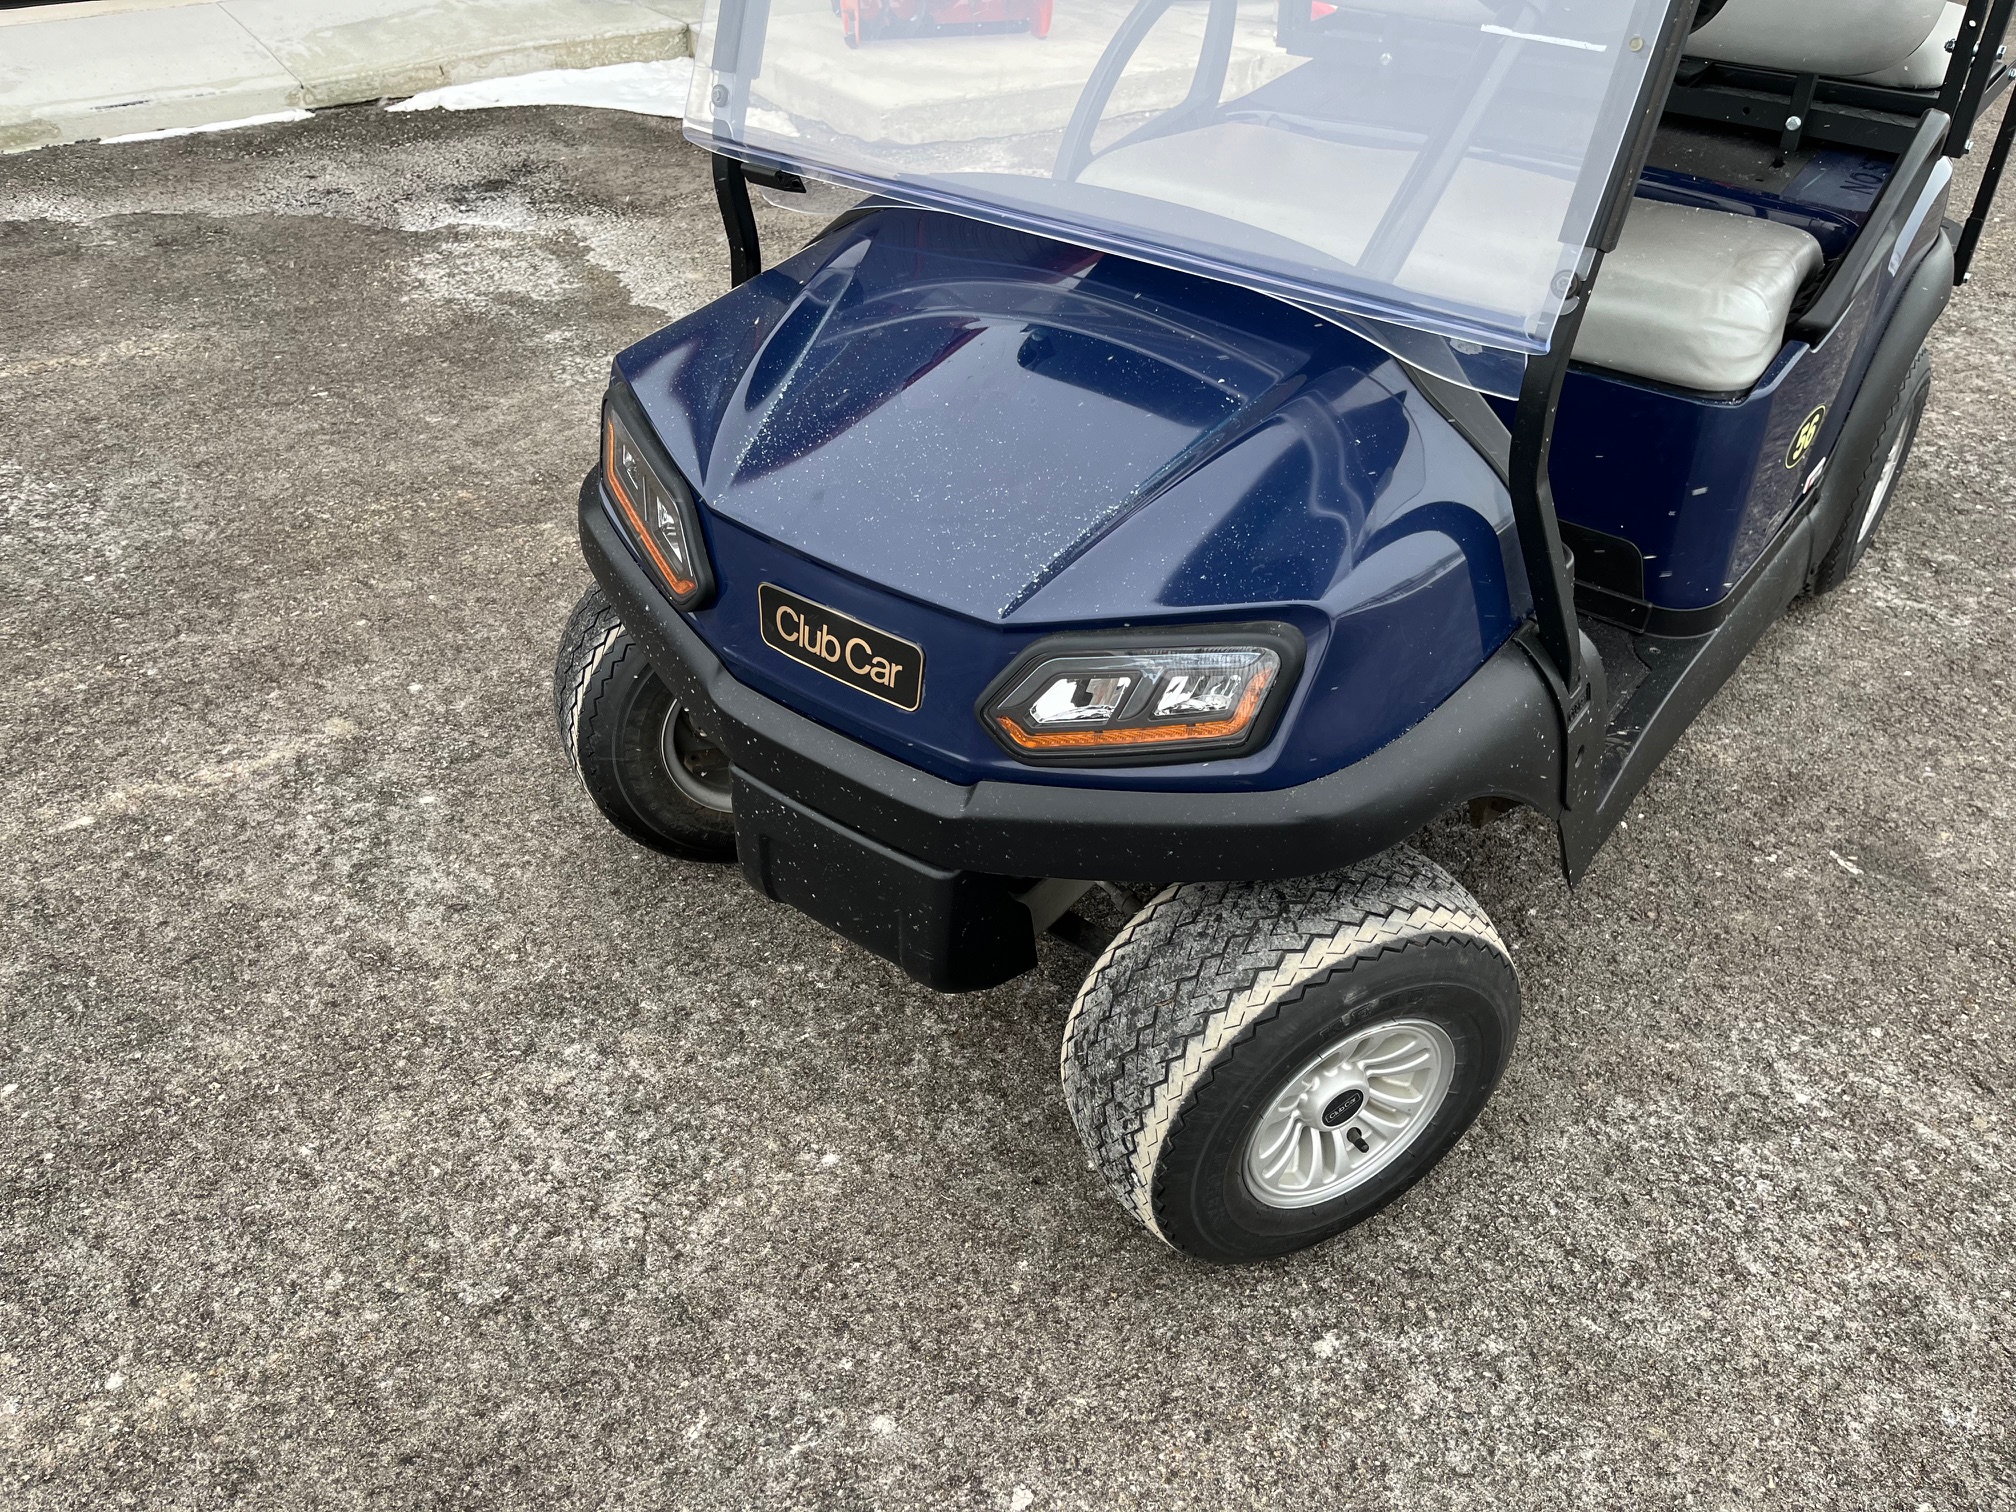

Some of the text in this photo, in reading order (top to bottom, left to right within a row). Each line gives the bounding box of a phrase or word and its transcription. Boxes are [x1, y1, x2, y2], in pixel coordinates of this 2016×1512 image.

[1793, 414, 1820, 460] 56
[776, 605, 903, 689] Club Car
